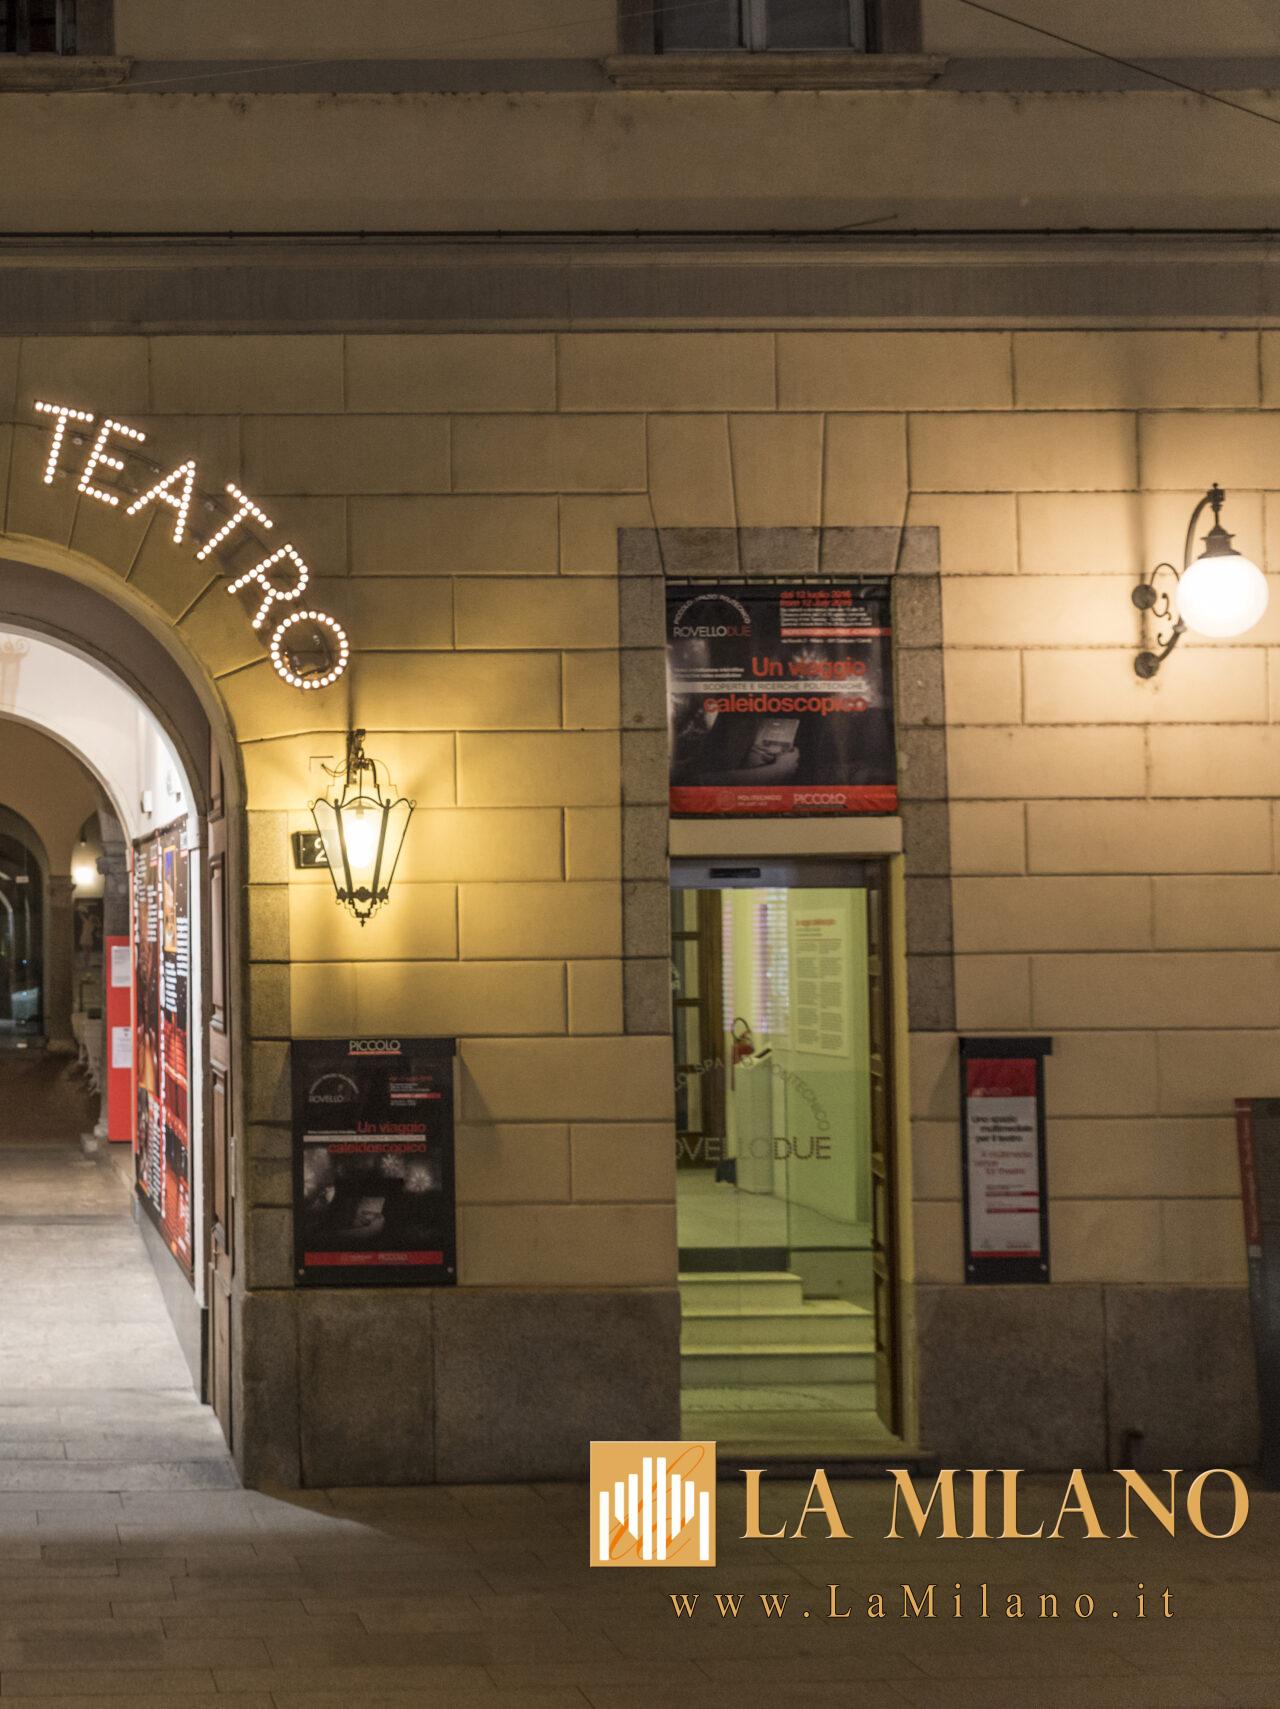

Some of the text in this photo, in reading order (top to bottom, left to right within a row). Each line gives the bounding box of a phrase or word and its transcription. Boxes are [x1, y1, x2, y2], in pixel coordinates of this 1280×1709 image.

[33, 399, 350, 690] TEATRO
[752, 656, 784, 677] Un
[788, 656, 866, 680] viaggio
[703, 693, 867, 716] caleidoscopico
[793, 793, 847, 805] PICCOLO
[349, 1039, 401, 1051] PICCOLO
[357, 1120, 426, 1135] Un viaggio
